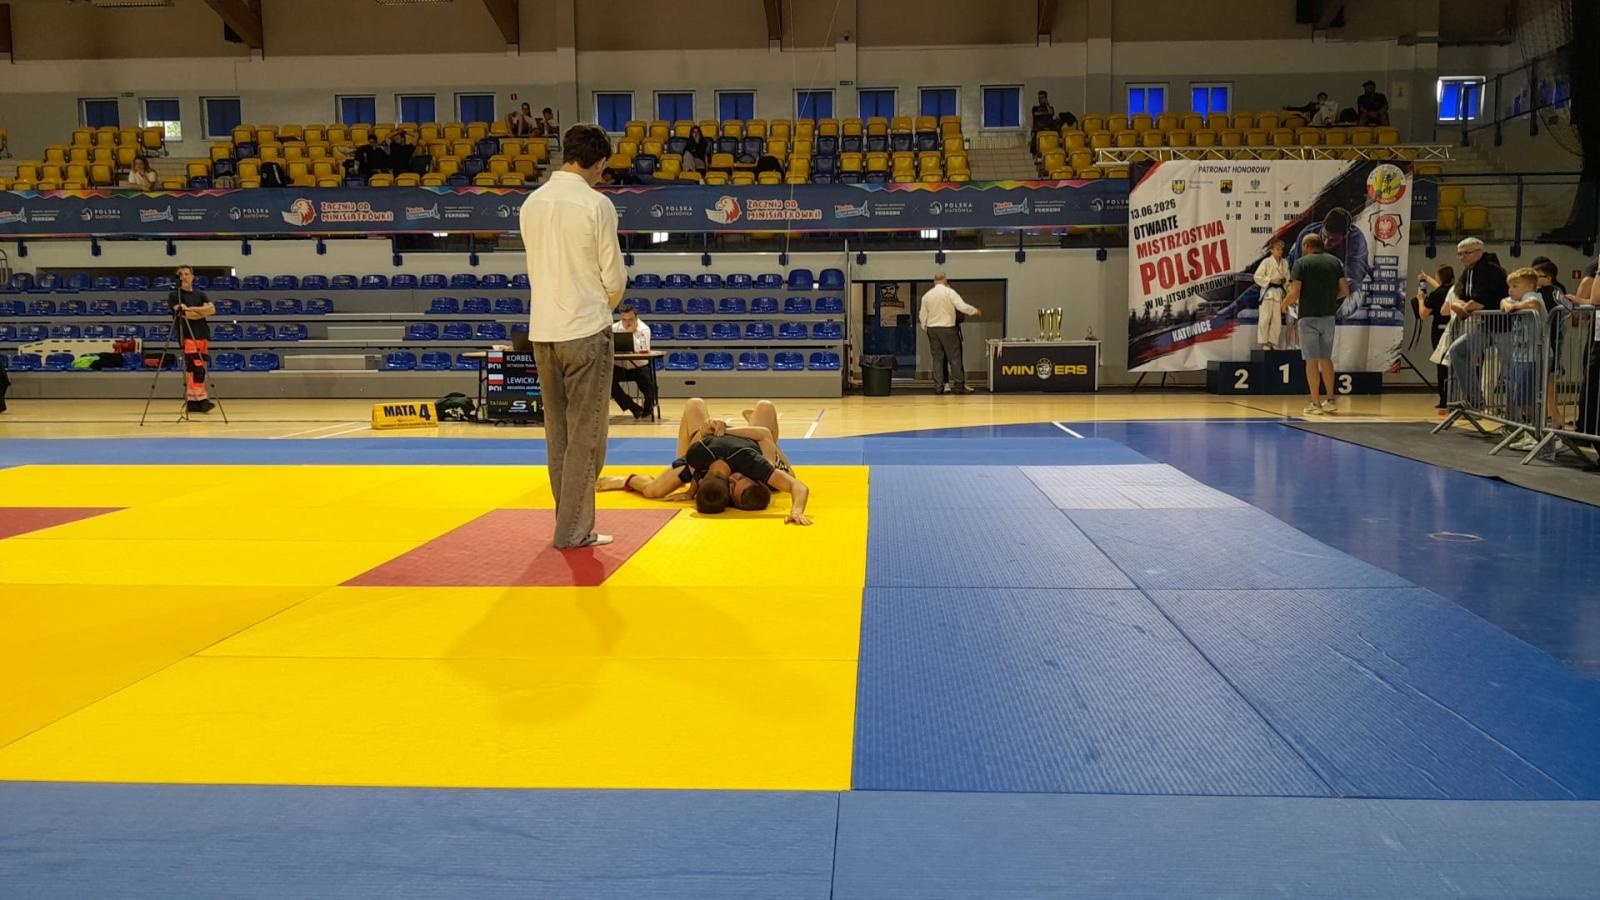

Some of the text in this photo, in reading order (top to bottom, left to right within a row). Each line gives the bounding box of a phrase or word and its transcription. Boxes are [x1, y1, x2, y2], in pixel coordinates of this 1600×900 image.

[1131, 199, 1176, 219] 13.06.2026
[1133, 215, 1178, 240] OTWARTE
[1136, 220, 1225, 259] MISTRZOSTWA
[1139, 239, 1231, 295] POLSKI
[1145, 274, 1234, 309] W JU-JITSU SPORTOWYM
[1171, 320, 1212, 342] KATOWICE
[1234, 368, 1249, 389] 2
[1279, 363, 1290, 384] 1
[1338, 374, 1353, 394] 3
[384, 404, 431, 420] MATA 4
